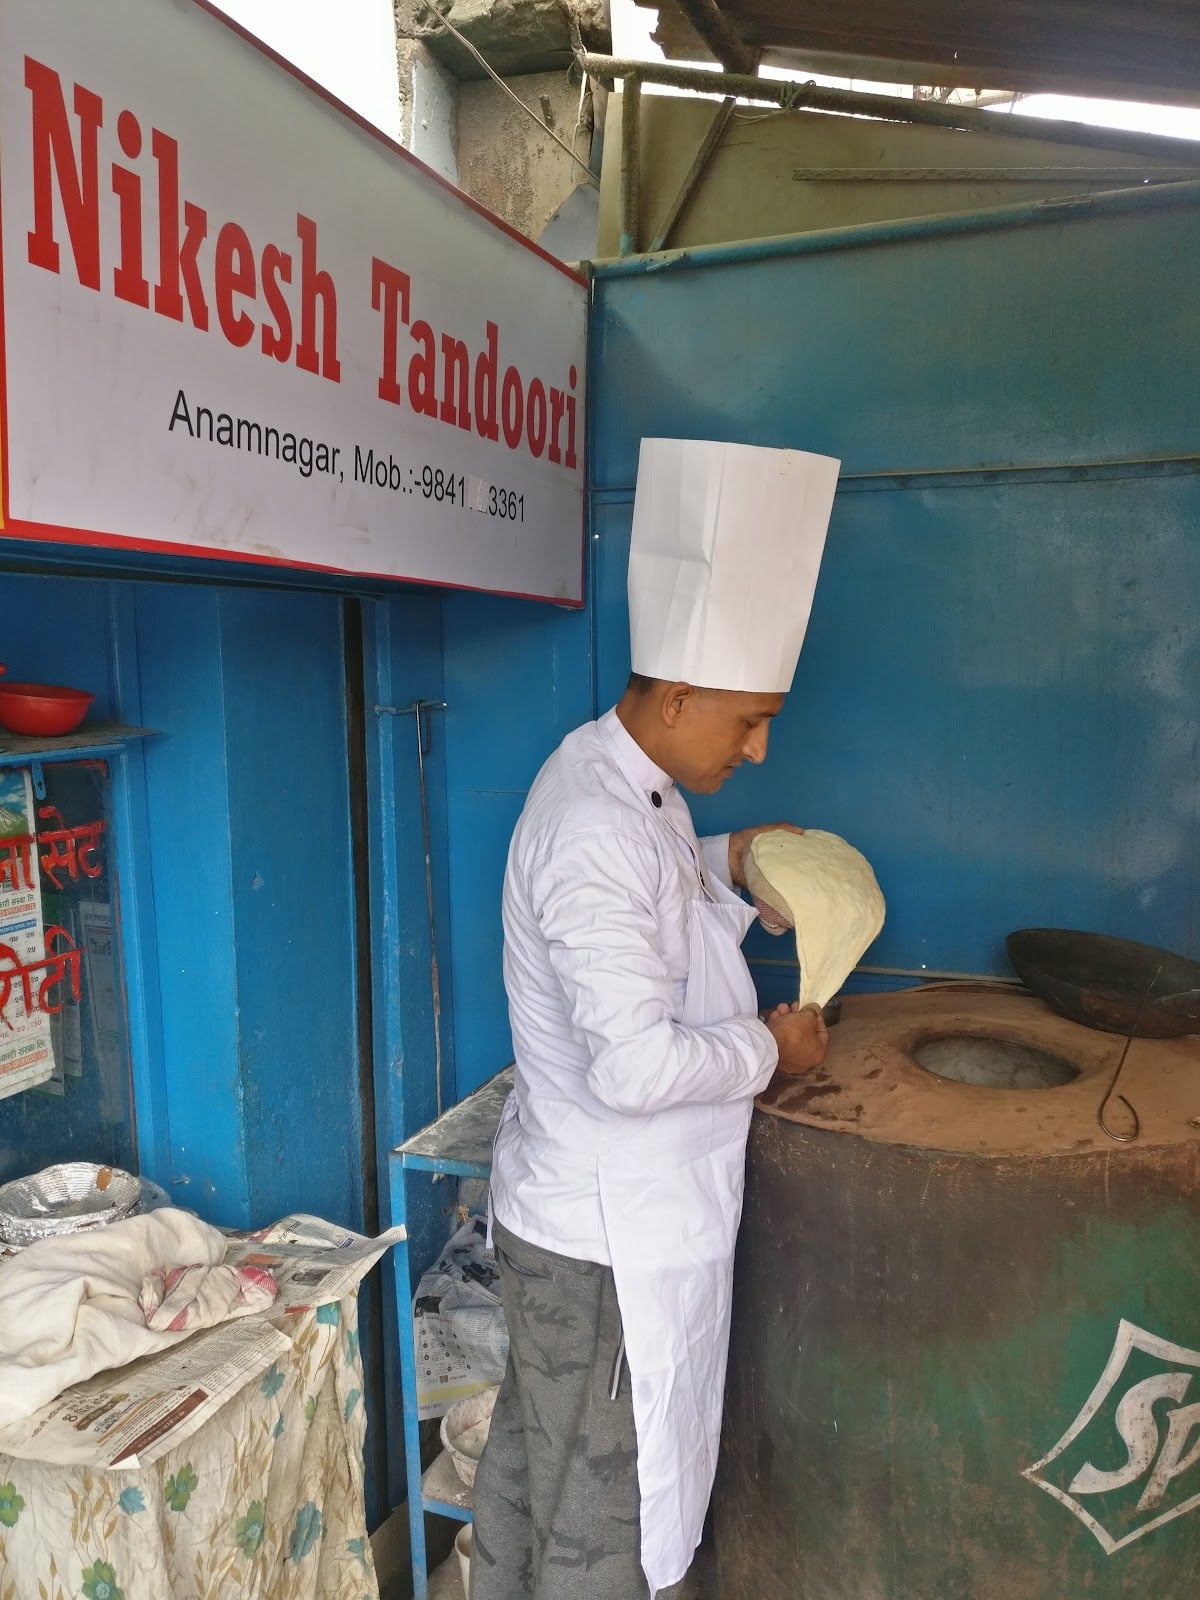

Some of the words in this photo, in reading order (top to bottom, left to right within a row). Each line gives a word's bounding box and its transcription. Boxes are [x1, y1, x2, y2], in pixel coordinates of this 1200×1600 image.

[24, 54, 341, 384] Nikesh
[371, 255, 577, 470] Tandoori
[168, 389, 344, 483] Anamnagar,
[354, 444, 524, 523] Mob.:-98413361
[38, 805, 107, 890] सेट
